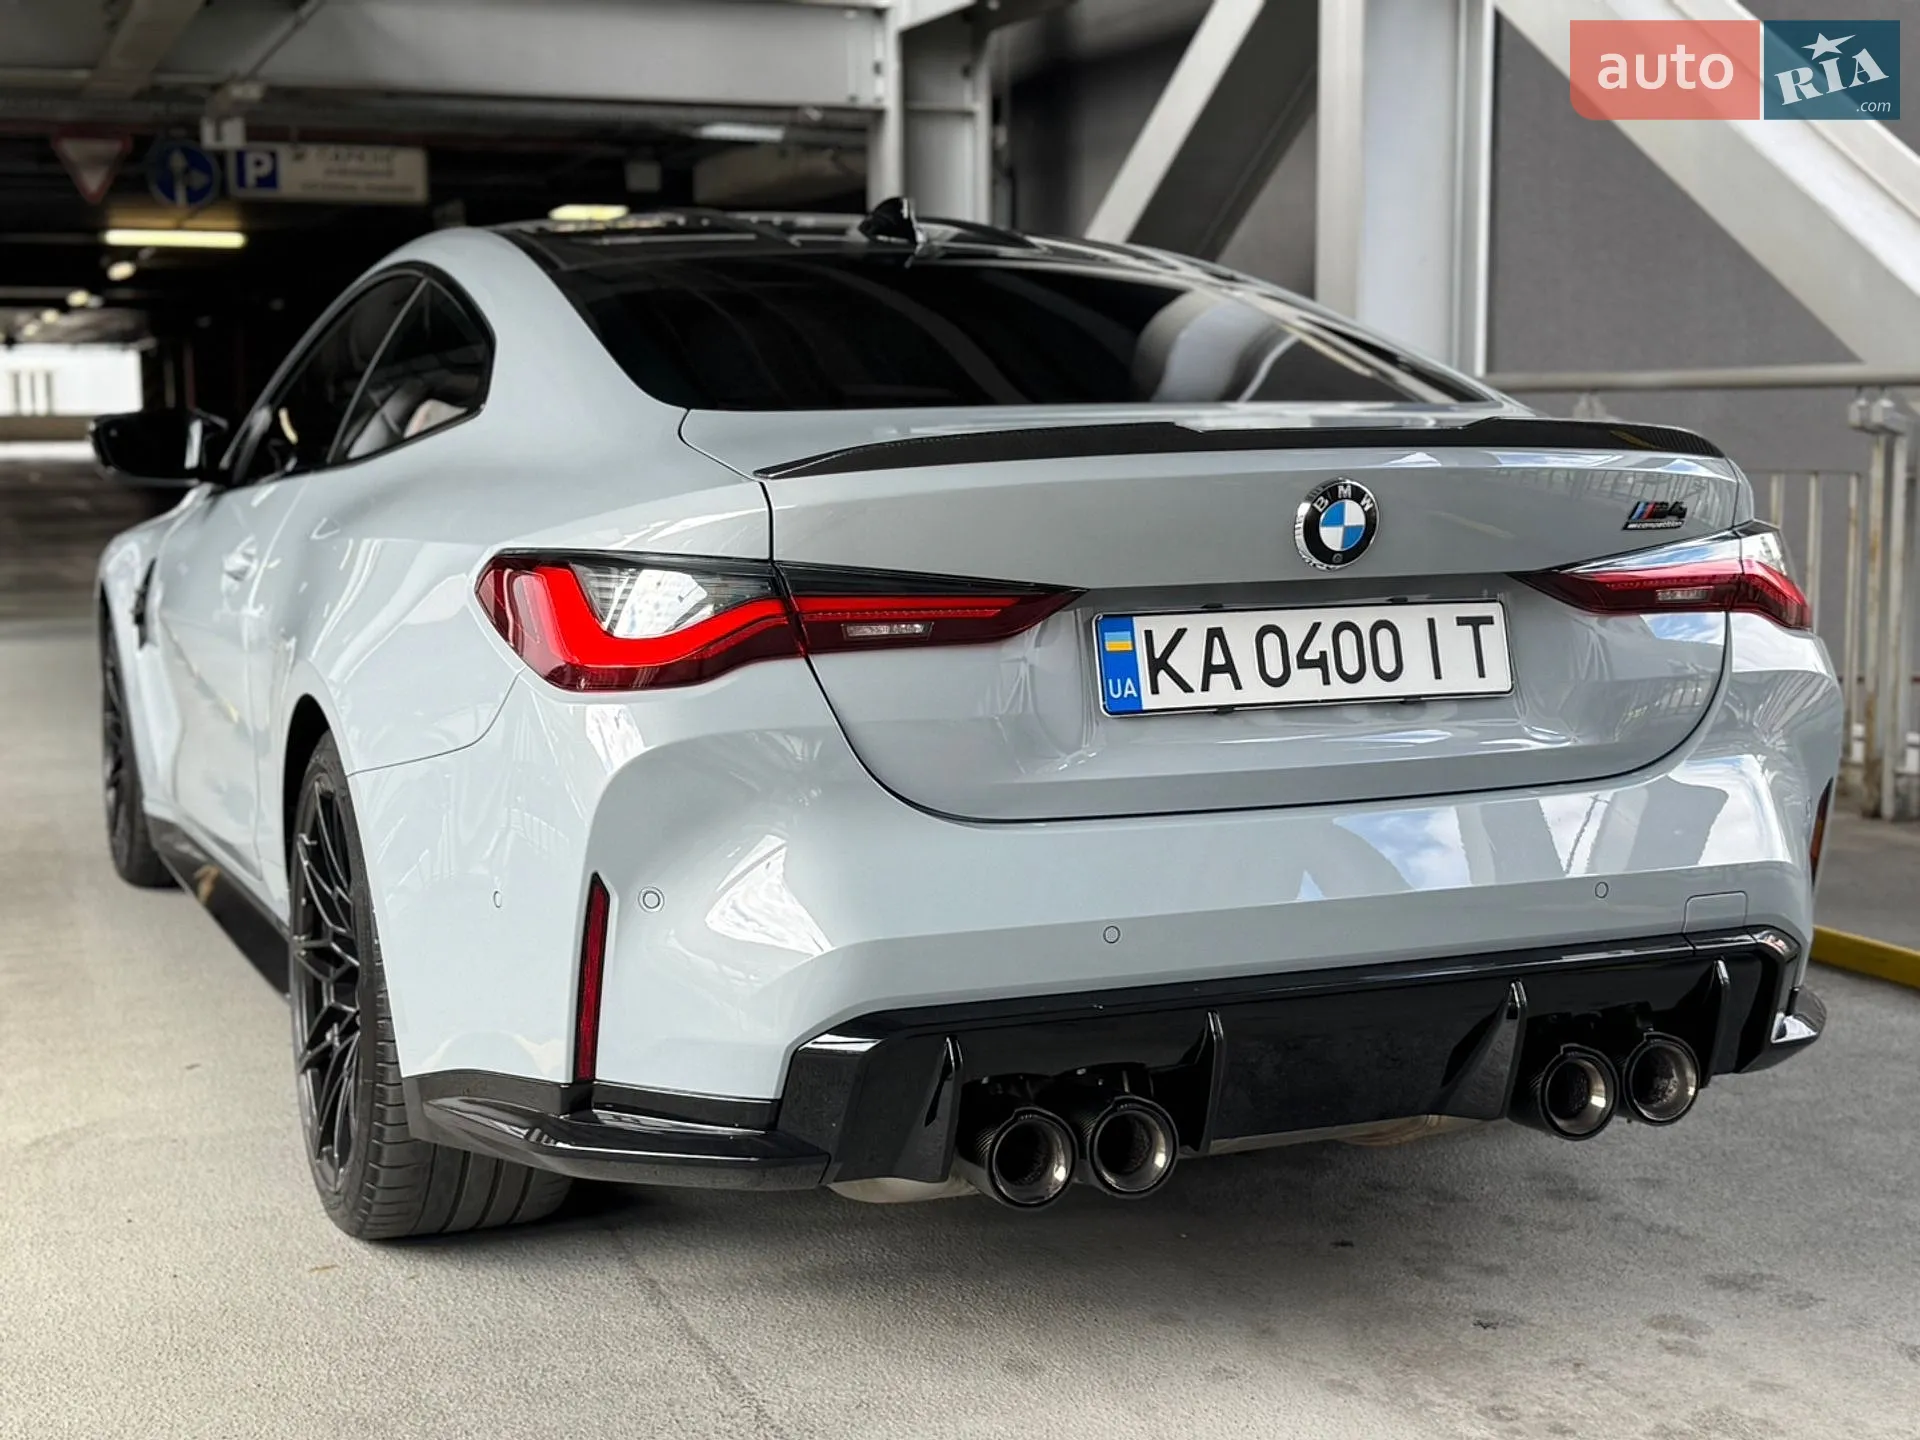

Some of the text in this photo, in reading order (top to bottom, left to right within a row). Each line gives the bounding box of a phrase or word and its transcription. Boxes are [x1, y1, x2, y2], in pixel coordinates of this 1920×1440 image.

[1312, 484, 1374, 513] BMW
[1144, 627, 1243, 695] KA
[1254, 619, 1405, 688] 0400
[1108, 677, 1138, 699] UA
